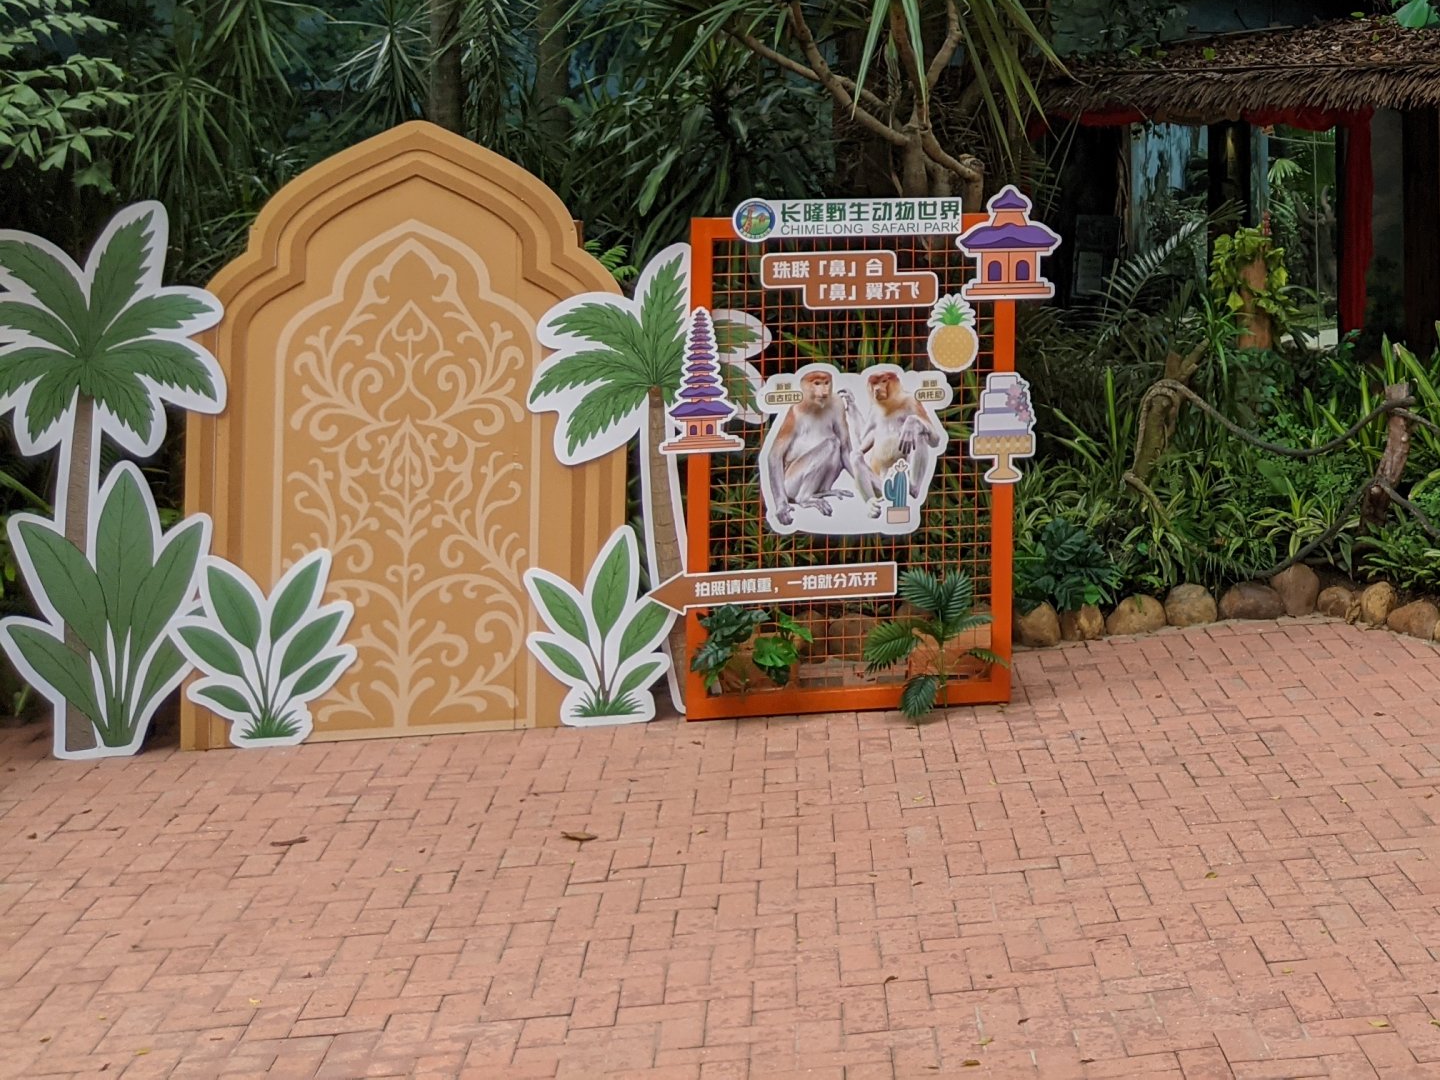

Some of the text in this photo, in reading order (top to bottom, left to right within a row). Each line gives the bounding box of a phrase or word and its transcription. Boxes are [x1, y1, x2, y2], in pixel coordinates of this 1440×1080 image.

[780, 199, 960, 223] 长隆野生动物世界
[781, 222, 960, 235] CHIMELONG SAFARI PARK
[694, 571, 878, 597] 拍照请慎重，一拍就分不开
